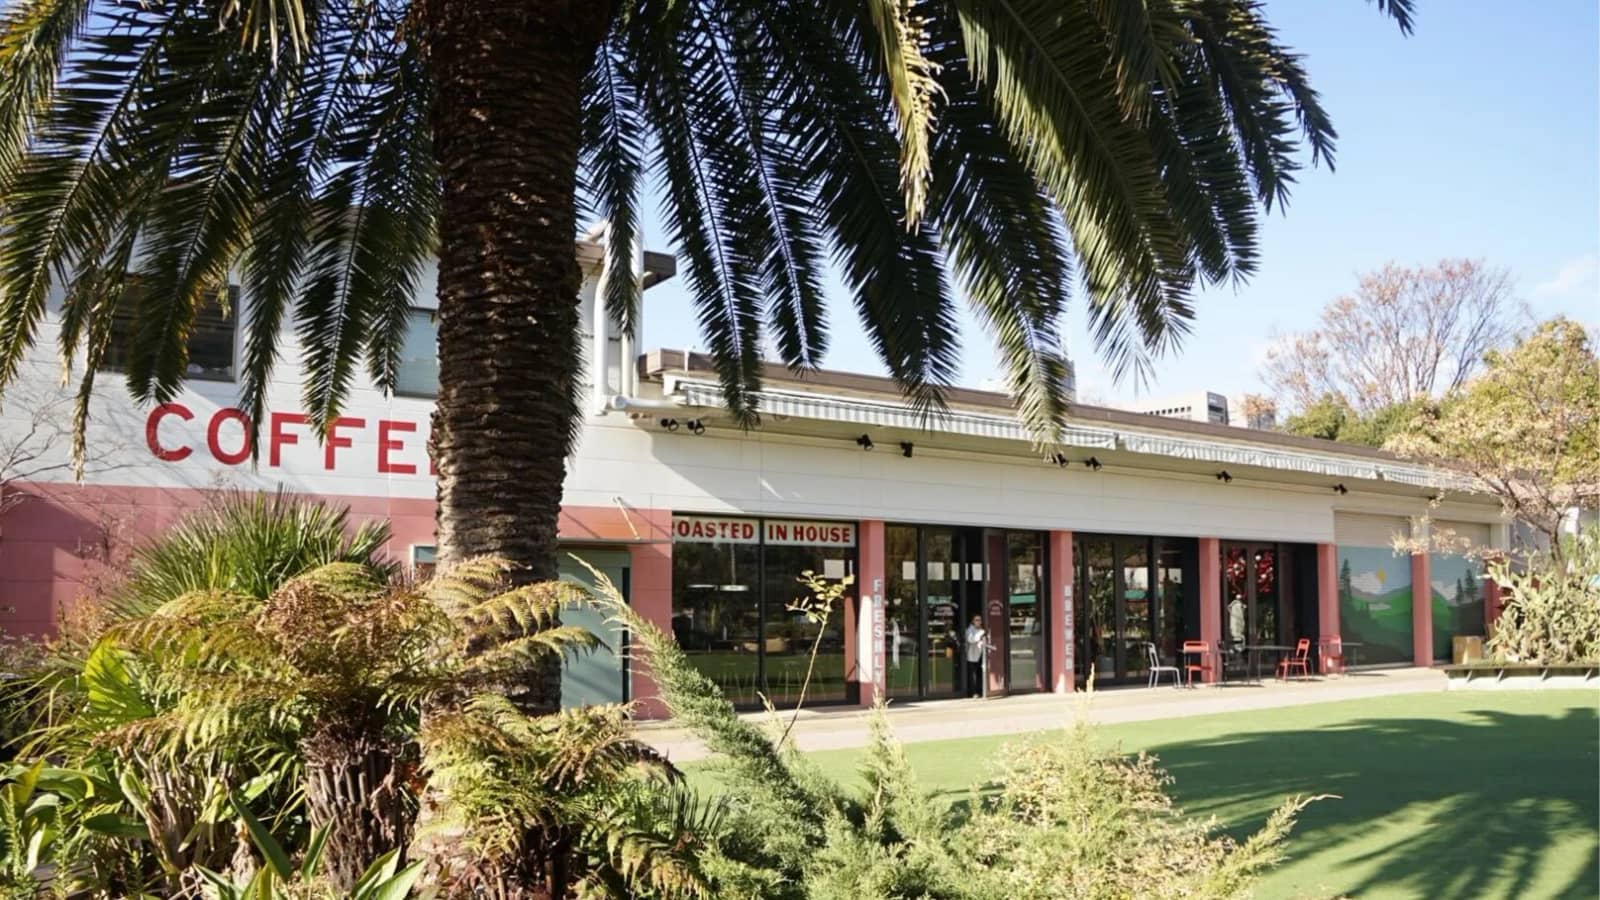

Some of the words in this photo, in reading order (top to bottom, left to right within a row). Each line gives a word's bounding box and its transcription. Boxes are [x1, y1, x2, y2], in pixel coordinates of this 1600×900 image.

[146, 403, 440, 475] COFFE
[672, 520, 754, 539] OASTED
[769, 524, 788, 541] IN
[793, 525, 851, 543] HOUSE
